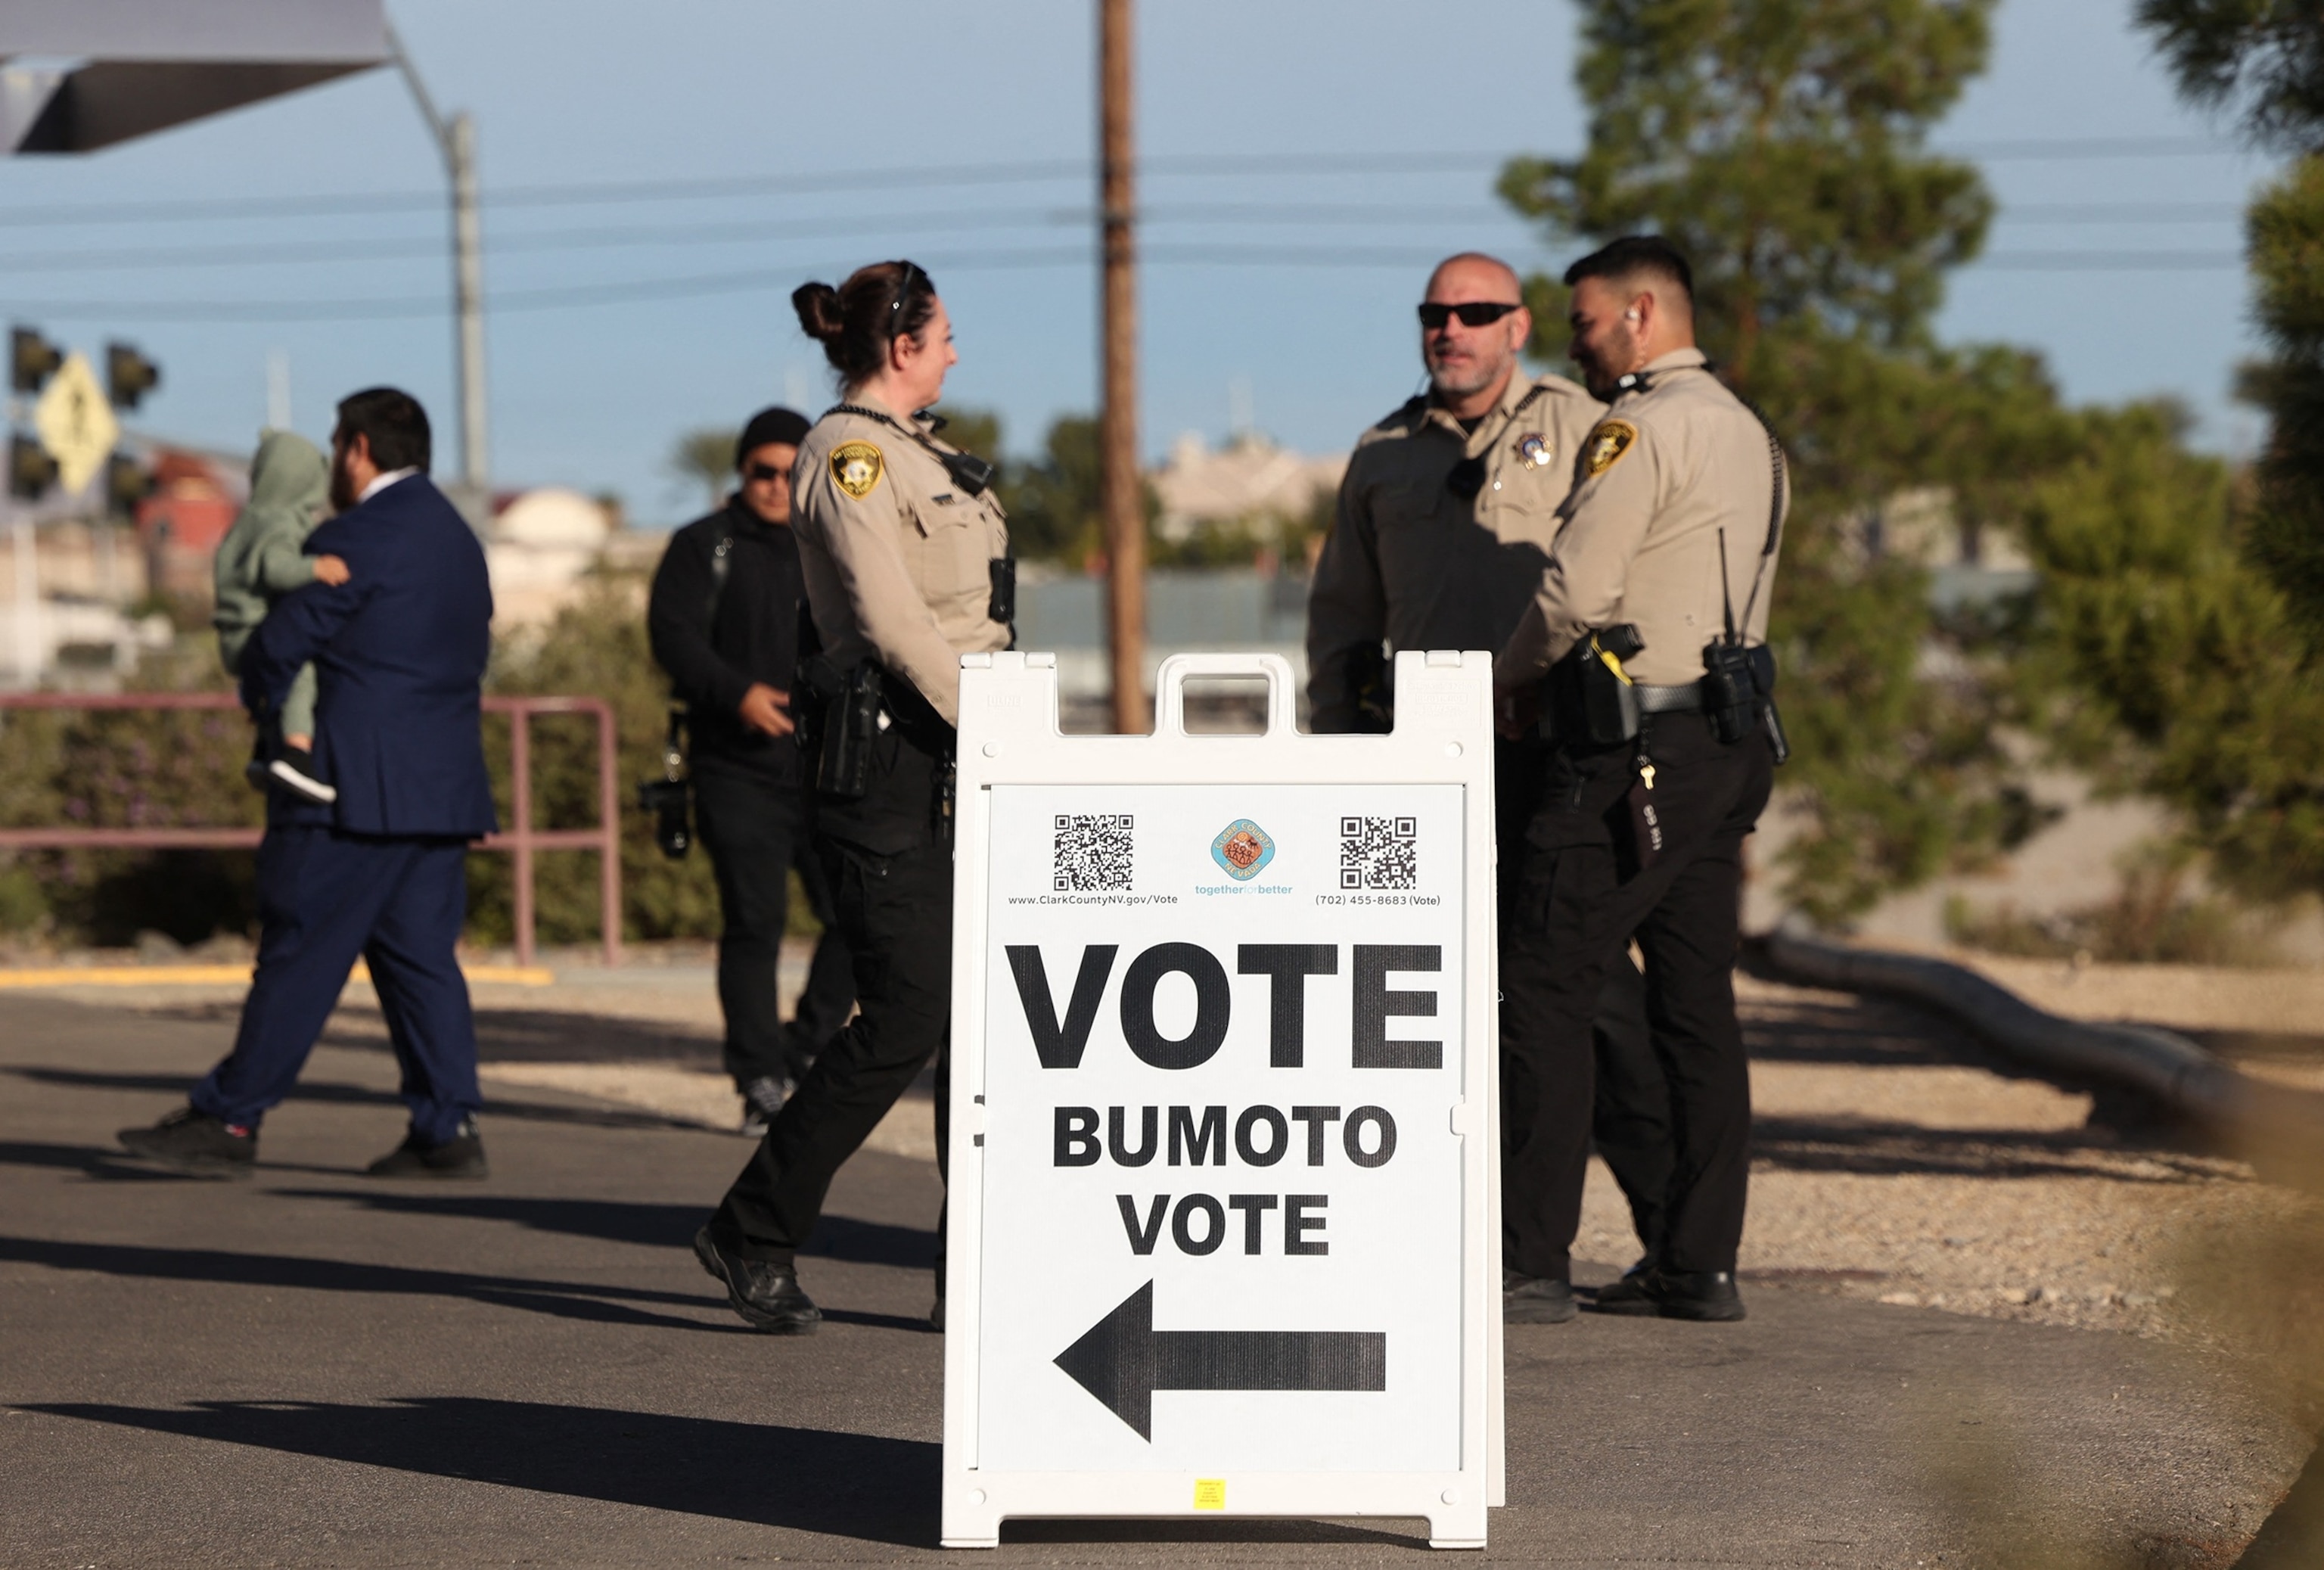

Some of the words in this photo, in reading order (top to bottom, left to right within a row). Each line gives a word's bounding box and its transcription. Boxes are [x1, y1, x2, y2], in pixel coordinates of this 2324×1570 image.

[1214, 825, 1238, 849] CLARK
[1241, 822, 1271, 849] COUNTY
[1224, 863, 1261, 878] NEVADA
[1008, 893, 1178, 906] www.ClarkCountyNV.gov/Vote
[1315, 894, 1347, 906] (702)
[1350, 894, 1407, 905] 455-8683
[1409, 894, 1440, 906] (Vote)
[1005, 942, 1443, 1070] VOTE
[1054, 1105, 1397, 1168] BUMOTO
[1116, 1193, 1329, 1257] VOTE
